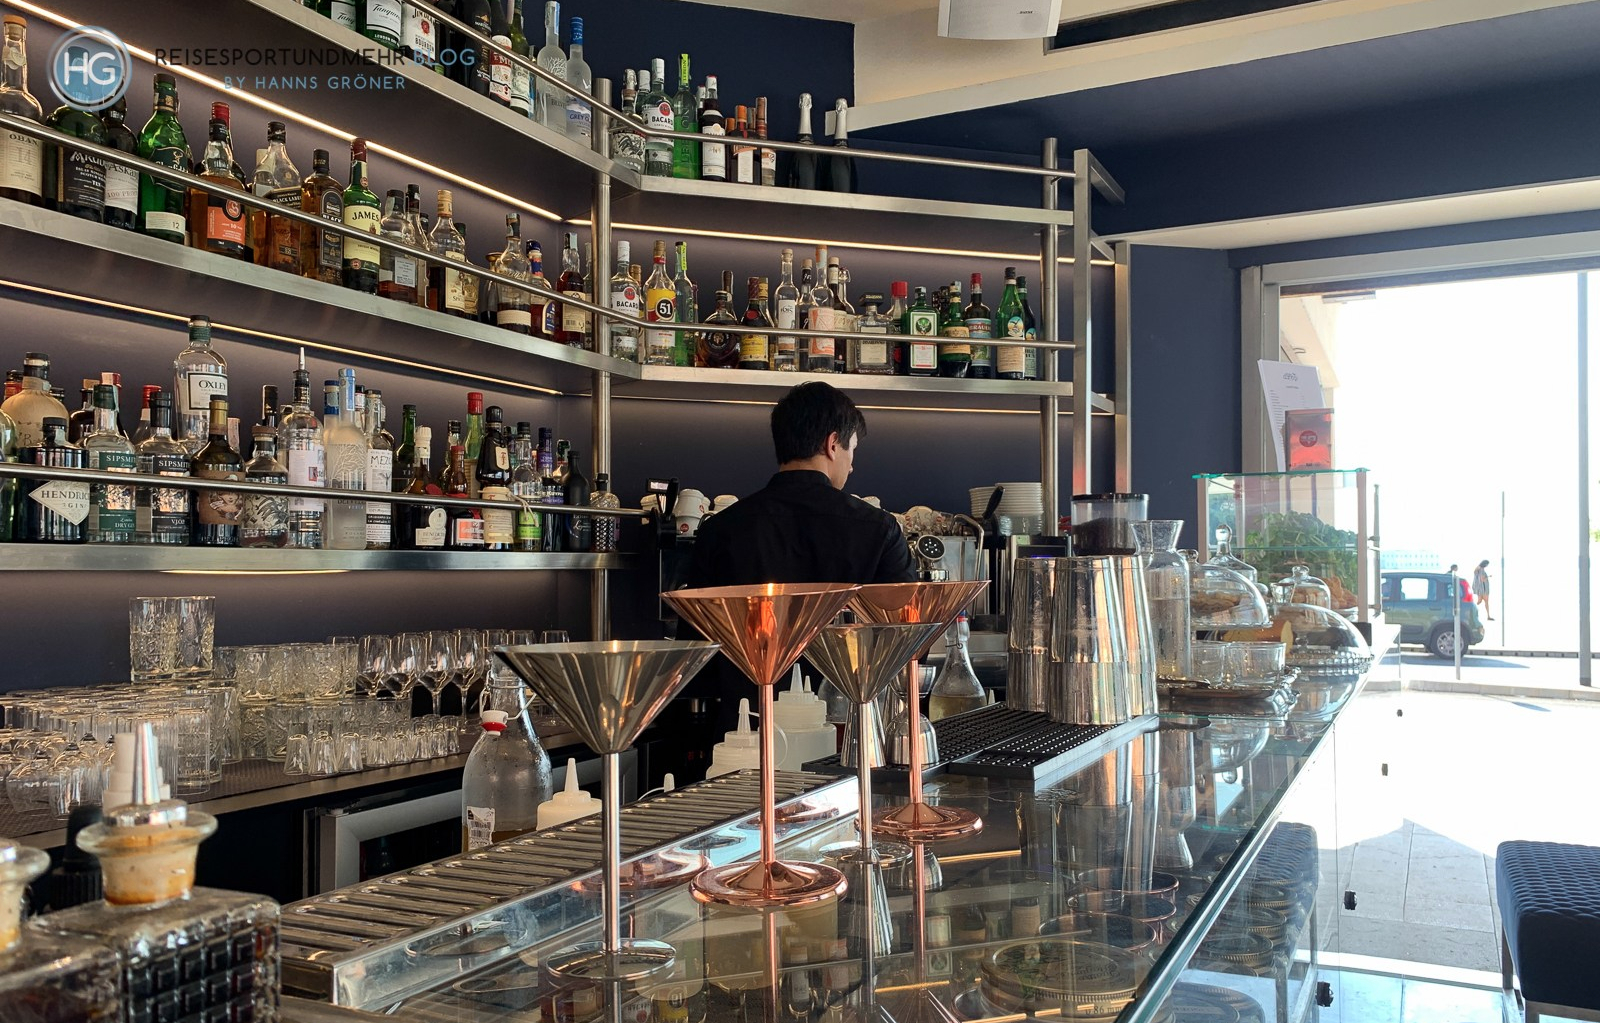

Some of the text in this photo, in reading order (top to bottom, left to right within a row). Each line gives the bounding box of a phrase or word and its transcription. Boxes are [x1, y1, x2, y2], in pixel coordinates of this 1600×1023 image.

[569, 113, 585, 121] GREY
[9, 133, 39, 146] OBAN
[172, 221, 180, 229] 12
[660, 302, 671, 315] 51
[1094, 1005, 1105, 1014] 86
